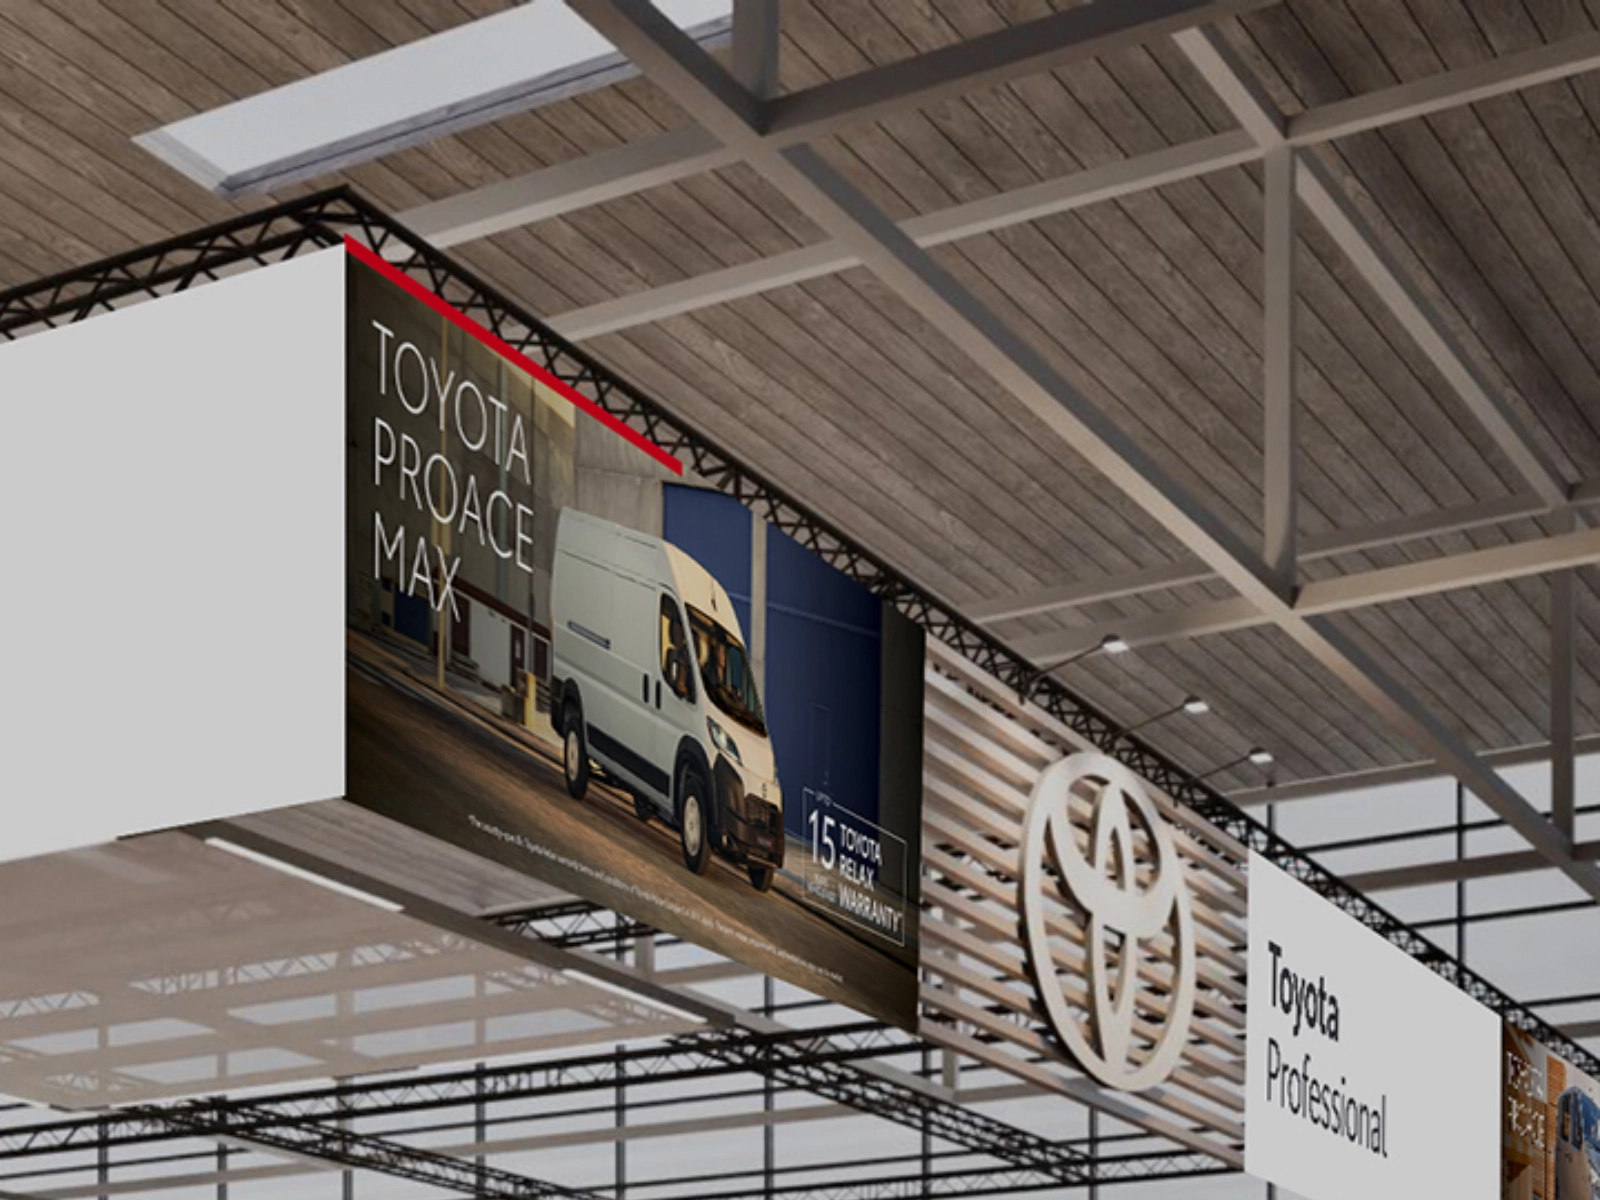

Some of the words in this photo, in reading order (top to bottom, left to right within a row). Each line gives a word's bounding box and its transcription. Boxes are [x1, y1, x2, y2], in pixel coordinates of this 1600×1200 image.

[372, 320, 531, 485] TOYOTA
[375, 417, 533, 574] PROACE
[375, 510, 461, 623] MAX
[808, 808, 836, 870] 15
[839, 823, 883, 866] TOYOTA
[839, 854, 875, 891] RELAX
[1268, 940, 1339, 1042] Toyota
[1266, 1037, 1388, 1159] Professional
